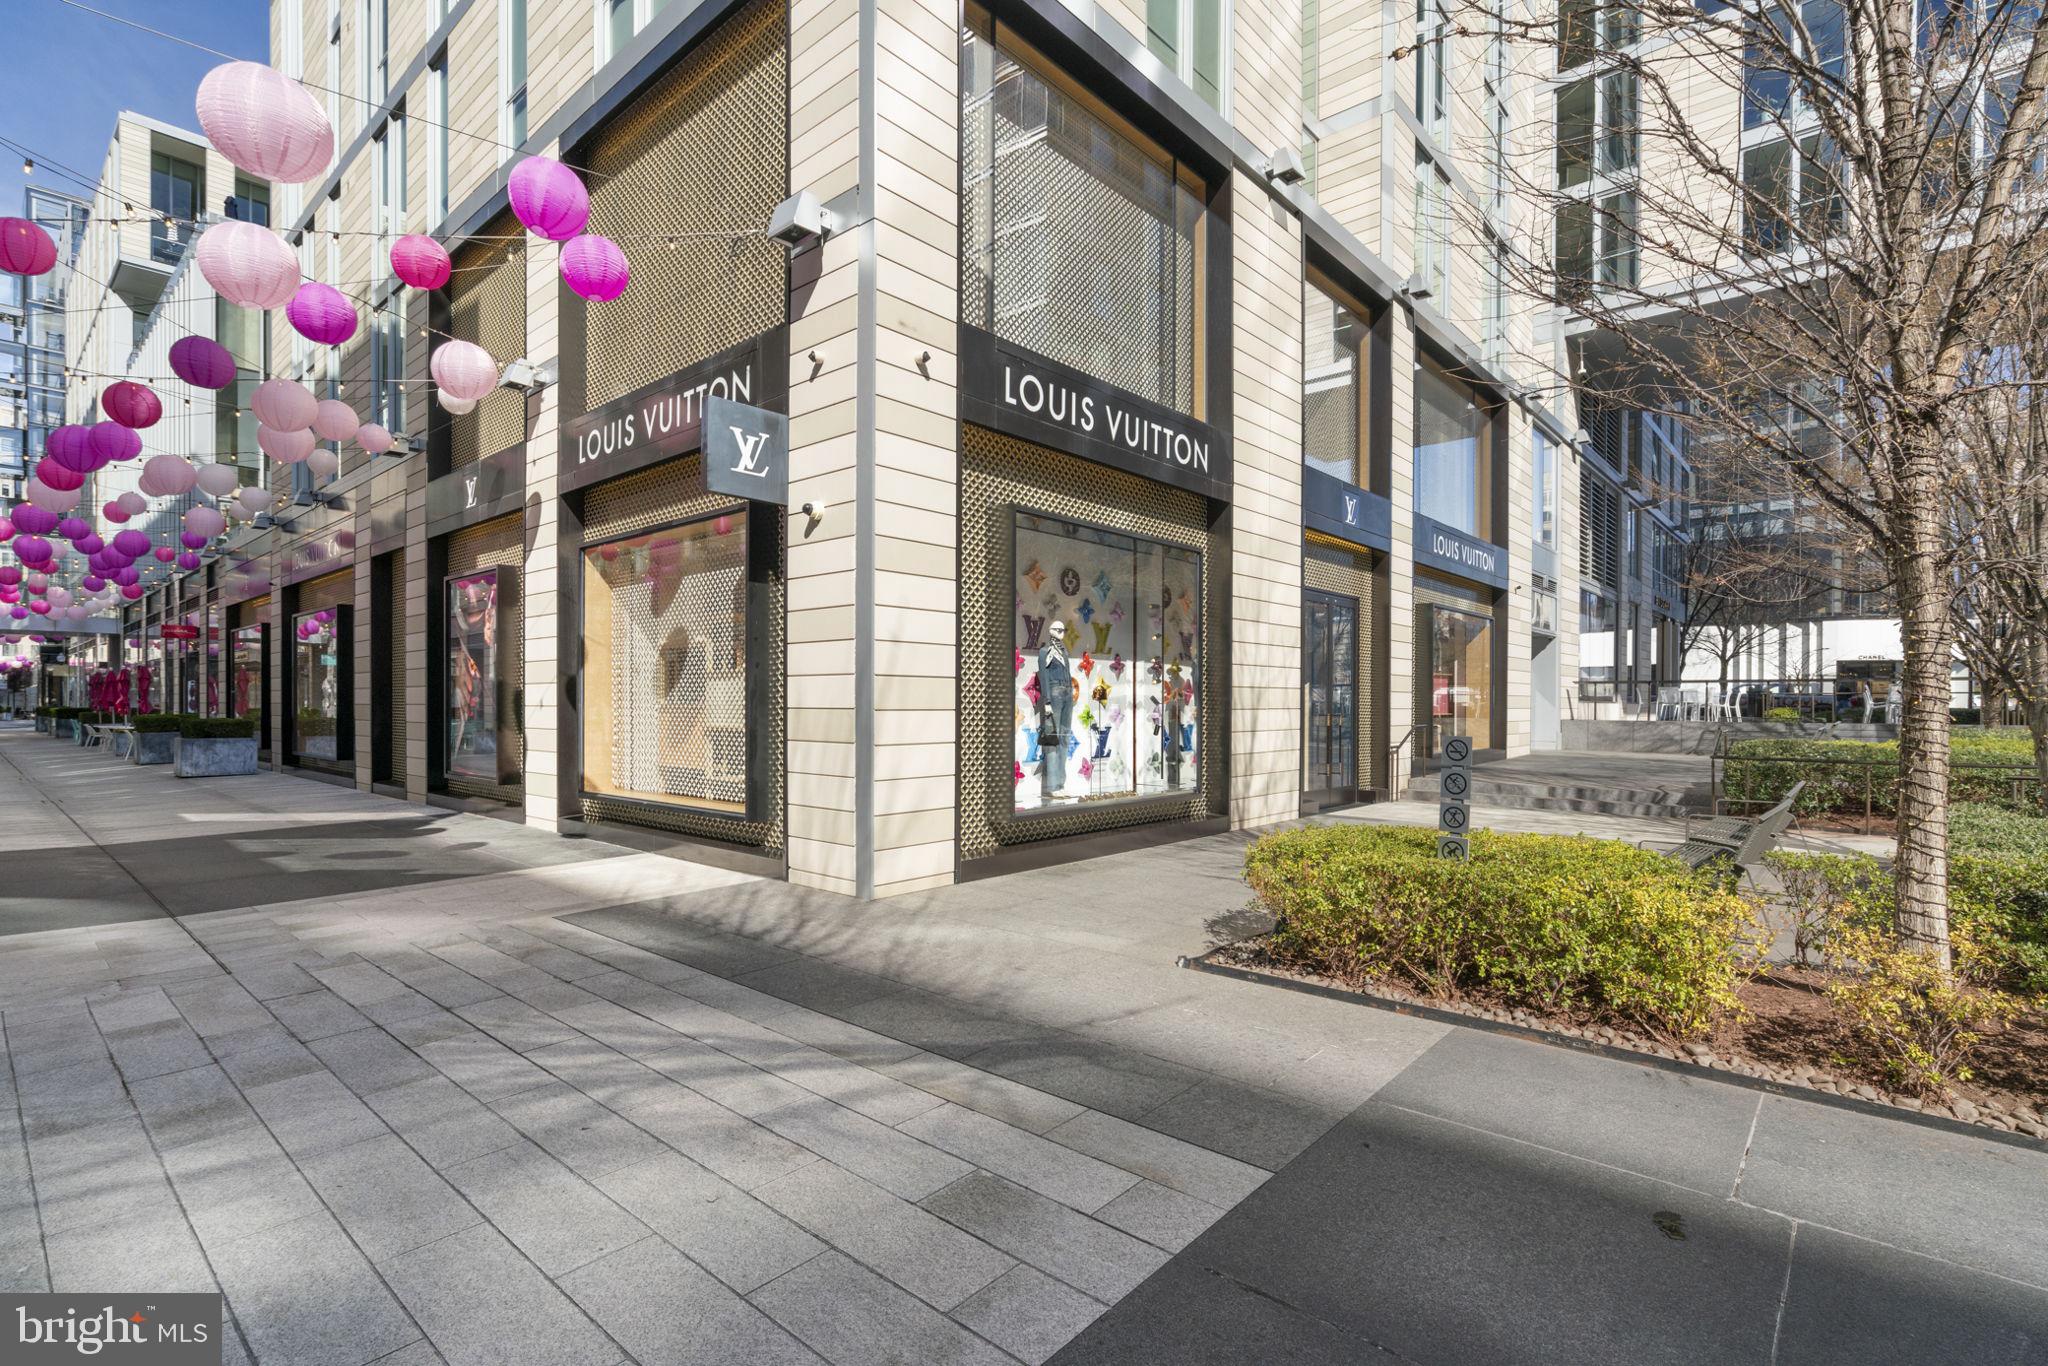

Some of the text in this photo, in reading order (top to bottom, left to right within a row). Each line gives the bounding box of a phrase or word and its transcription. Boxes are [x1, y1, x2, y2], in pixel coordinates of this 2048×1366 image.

[578, 364, 751, 465] LOUIS VUITTON
[729, 425, 770, 479] LV
[1004, 366, 1209, 474] LOUIS VUITTON
[1433, 533, 1495, 574] LOUIS VUITTON
